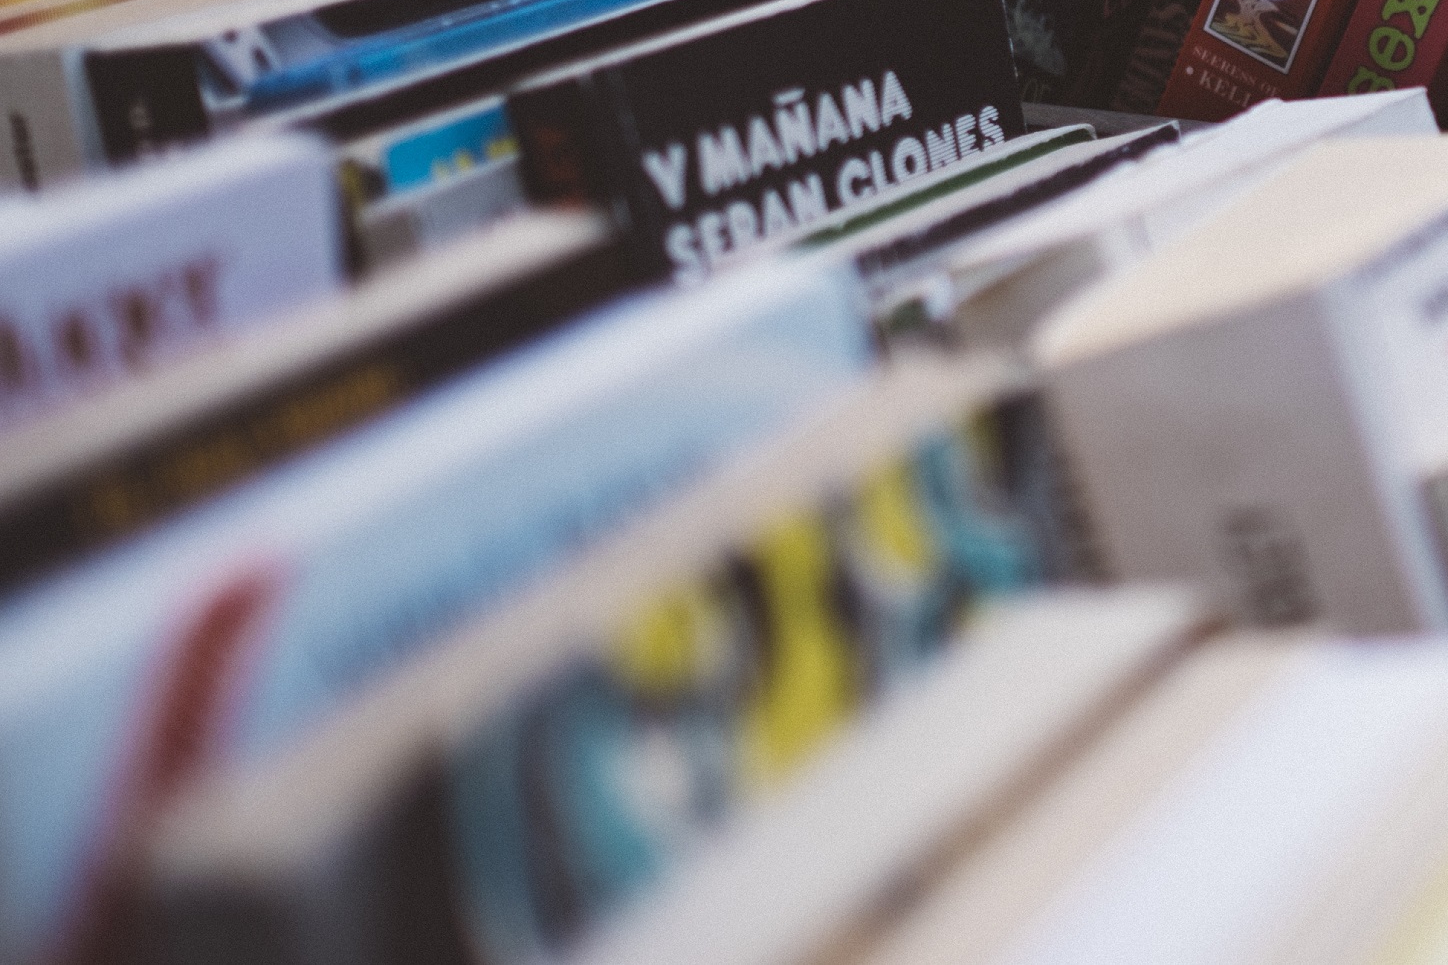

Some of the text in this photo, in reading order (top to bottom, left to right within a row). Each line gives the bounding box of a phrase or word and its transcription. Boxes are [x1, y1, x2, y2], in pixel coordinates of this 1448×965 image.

[643, 69, 914, 210] Y MAÑANA
[836, 105, 1006, 208] CLONES
